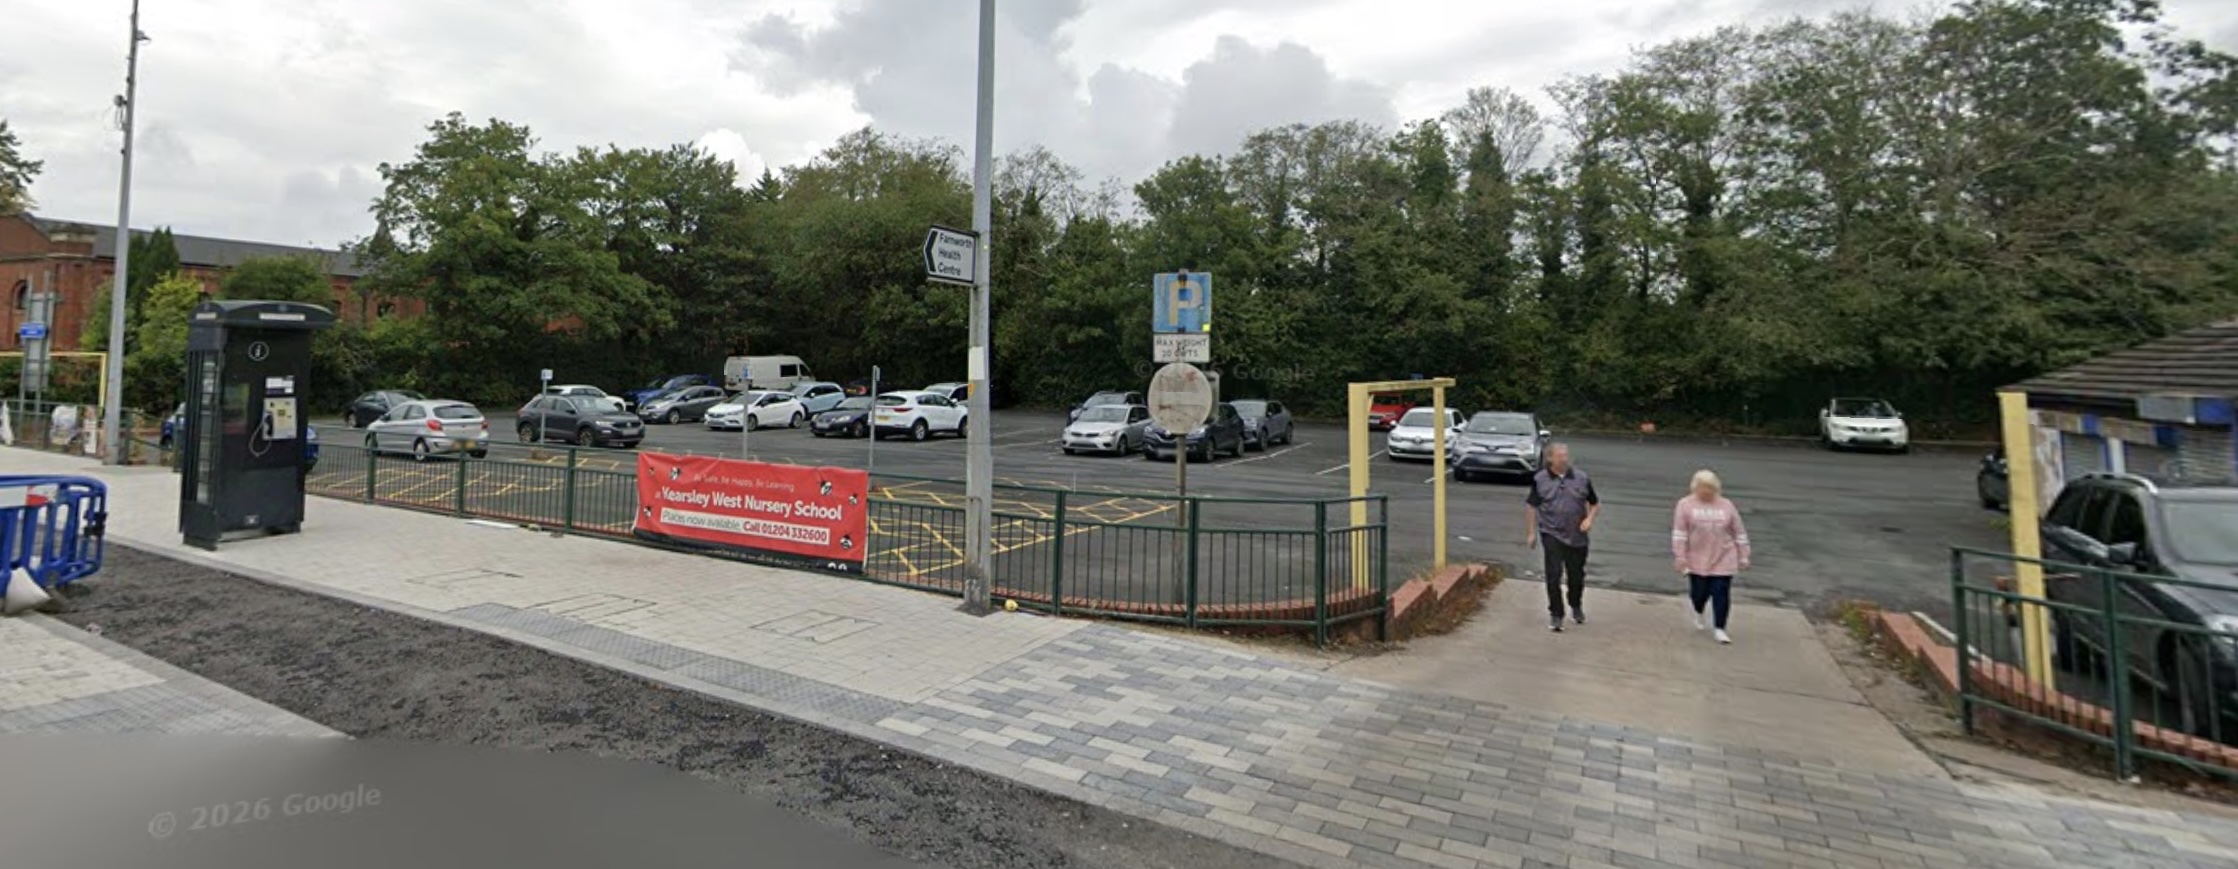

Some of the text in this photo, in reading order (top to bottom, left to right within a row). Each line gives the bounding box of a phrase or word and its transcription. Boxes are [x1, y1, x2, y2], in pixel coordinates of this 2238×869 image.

[938, 247, 961, 261] Health
[938, 262, 961, 276] Centre
[1169, 280, 1204, 326] P
[1156, 336, 1207, 347] MAX WEIGHT
[755, 478, 765, 486] Be
[766, 480, 795, 492] Learning
[662, 486, 710, 508] Kearsley
[712, 491, 742, 508] West
[744, 495, 792, 518] Nursery
[794, 500, 842, 520] School
[685, 515, 706, 525] now
[743, 521, 760, 533] Call
[761, 523, 790, 536] 01204
[791, 527, 827, 542] 332600
